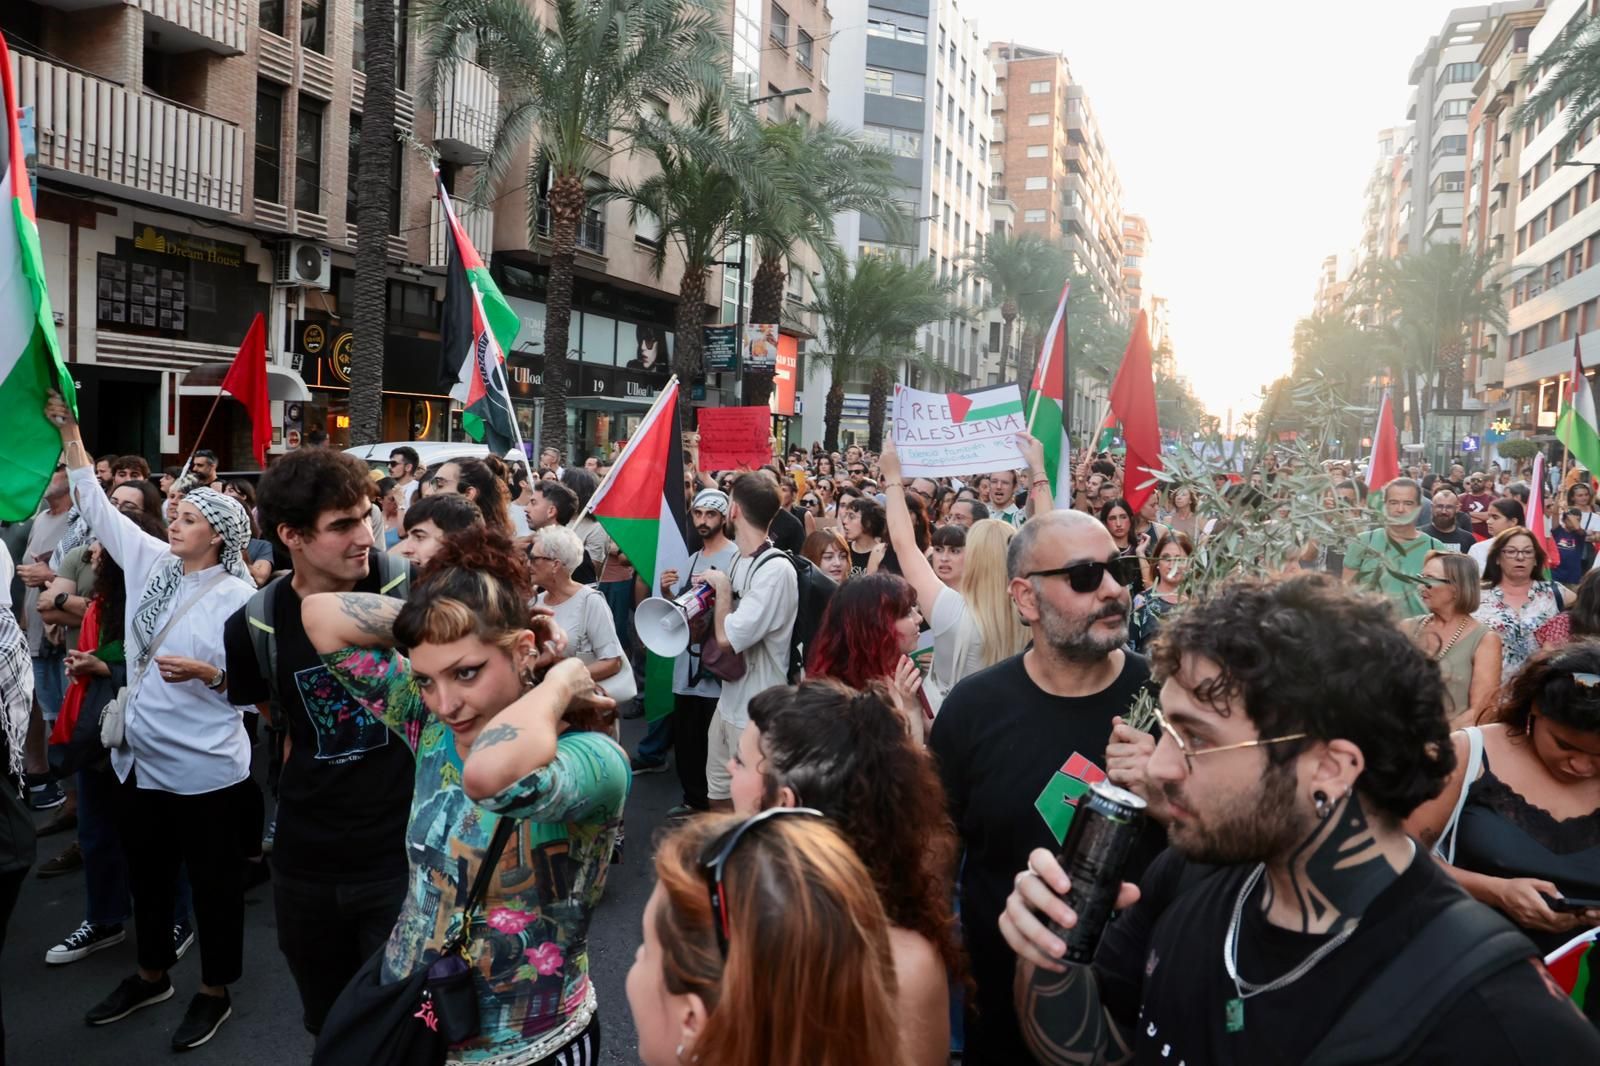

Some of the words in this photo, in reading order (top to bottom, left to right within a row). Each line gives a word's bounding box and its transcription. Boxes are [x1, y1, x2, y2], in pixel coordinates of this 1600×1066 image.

[167, 242, 204, 260] Dream
[208, 248, 240, 267] House
[787, 356, 797, 368] XXI
[593, 380, 604, 392] 19
[900, 389, 951, 420] FREE
[896, 414, 1020, 441] PALESTINA
